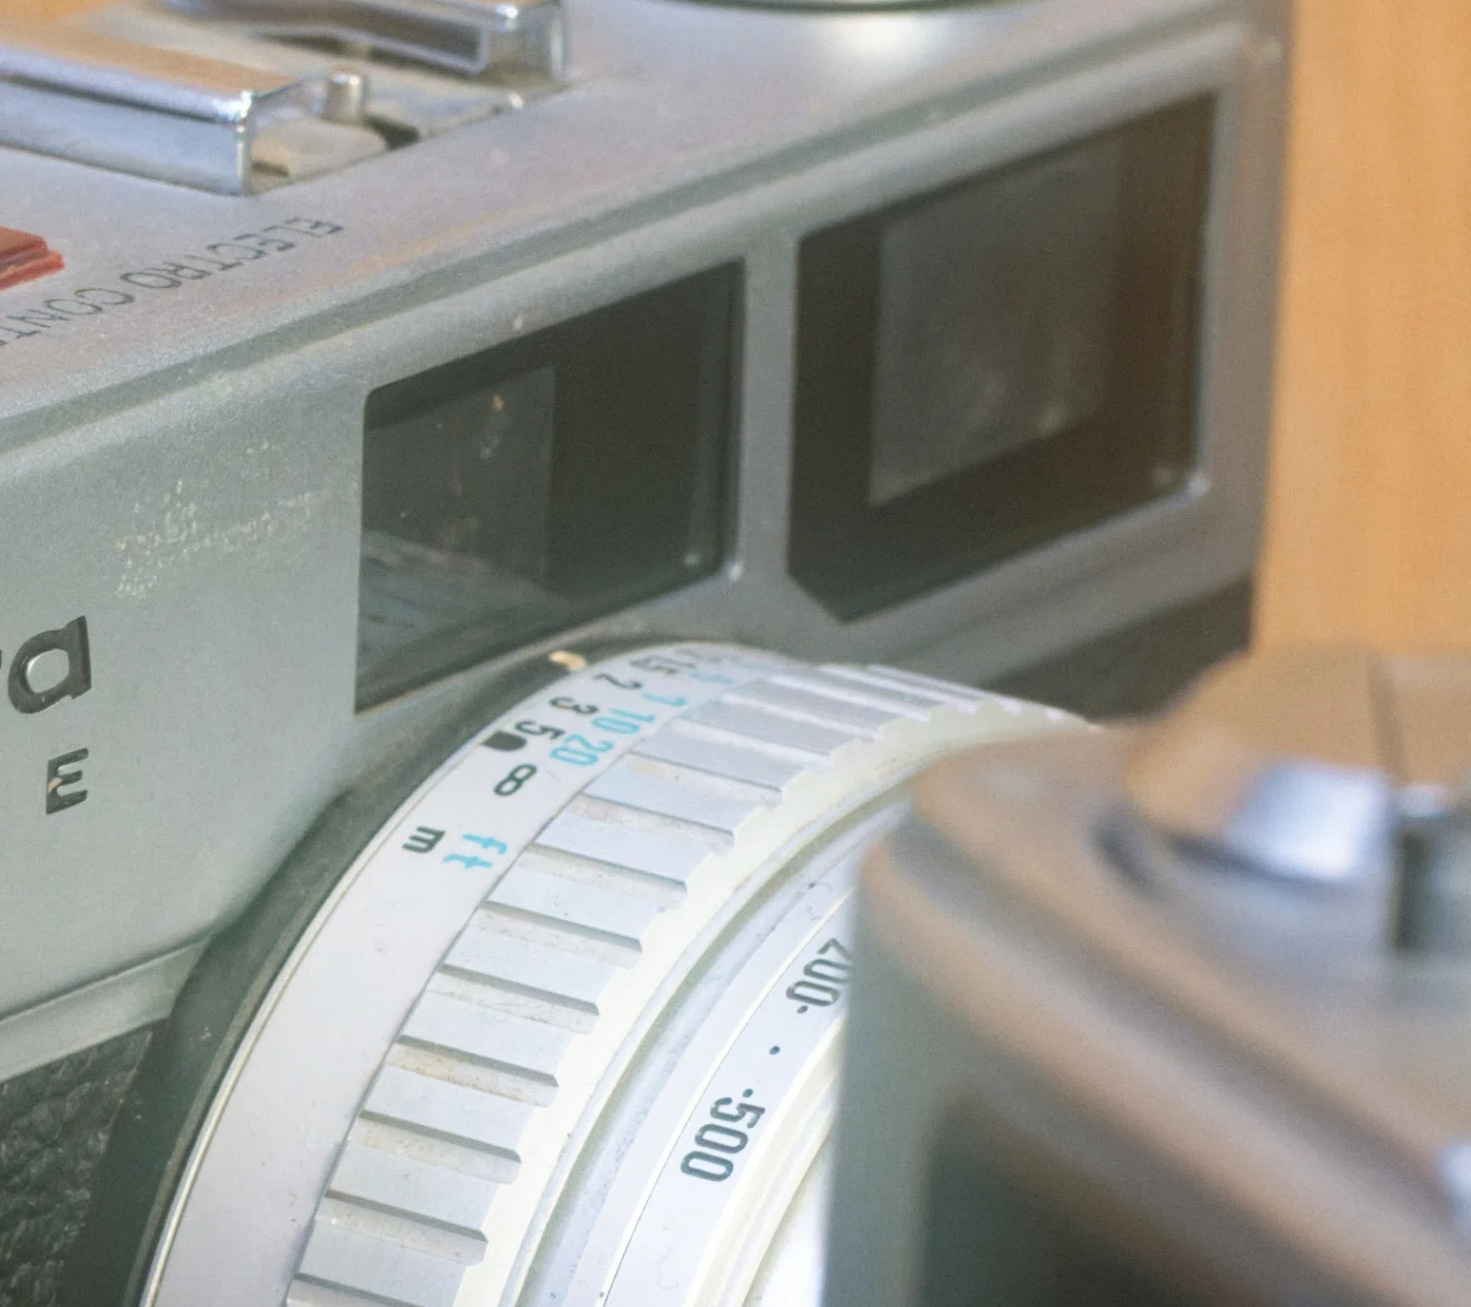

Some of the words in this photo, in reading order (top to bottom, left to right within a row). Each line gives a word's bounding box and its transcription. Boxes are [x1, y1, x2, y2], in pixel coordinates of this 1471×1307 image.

[119, 216, 345, 291] ELECTRO
[549, 696, 599, 716] 3
[590, 707, 656, 735] 10
[514, 719, 566, 740] 5
[548, 733, 615, 767] 20
[44, 747, 90, 815] E
[401, 826, 446, 854] m
[442, 833, 508, 869] ft
[679, 1097, 766, 1183] 500
